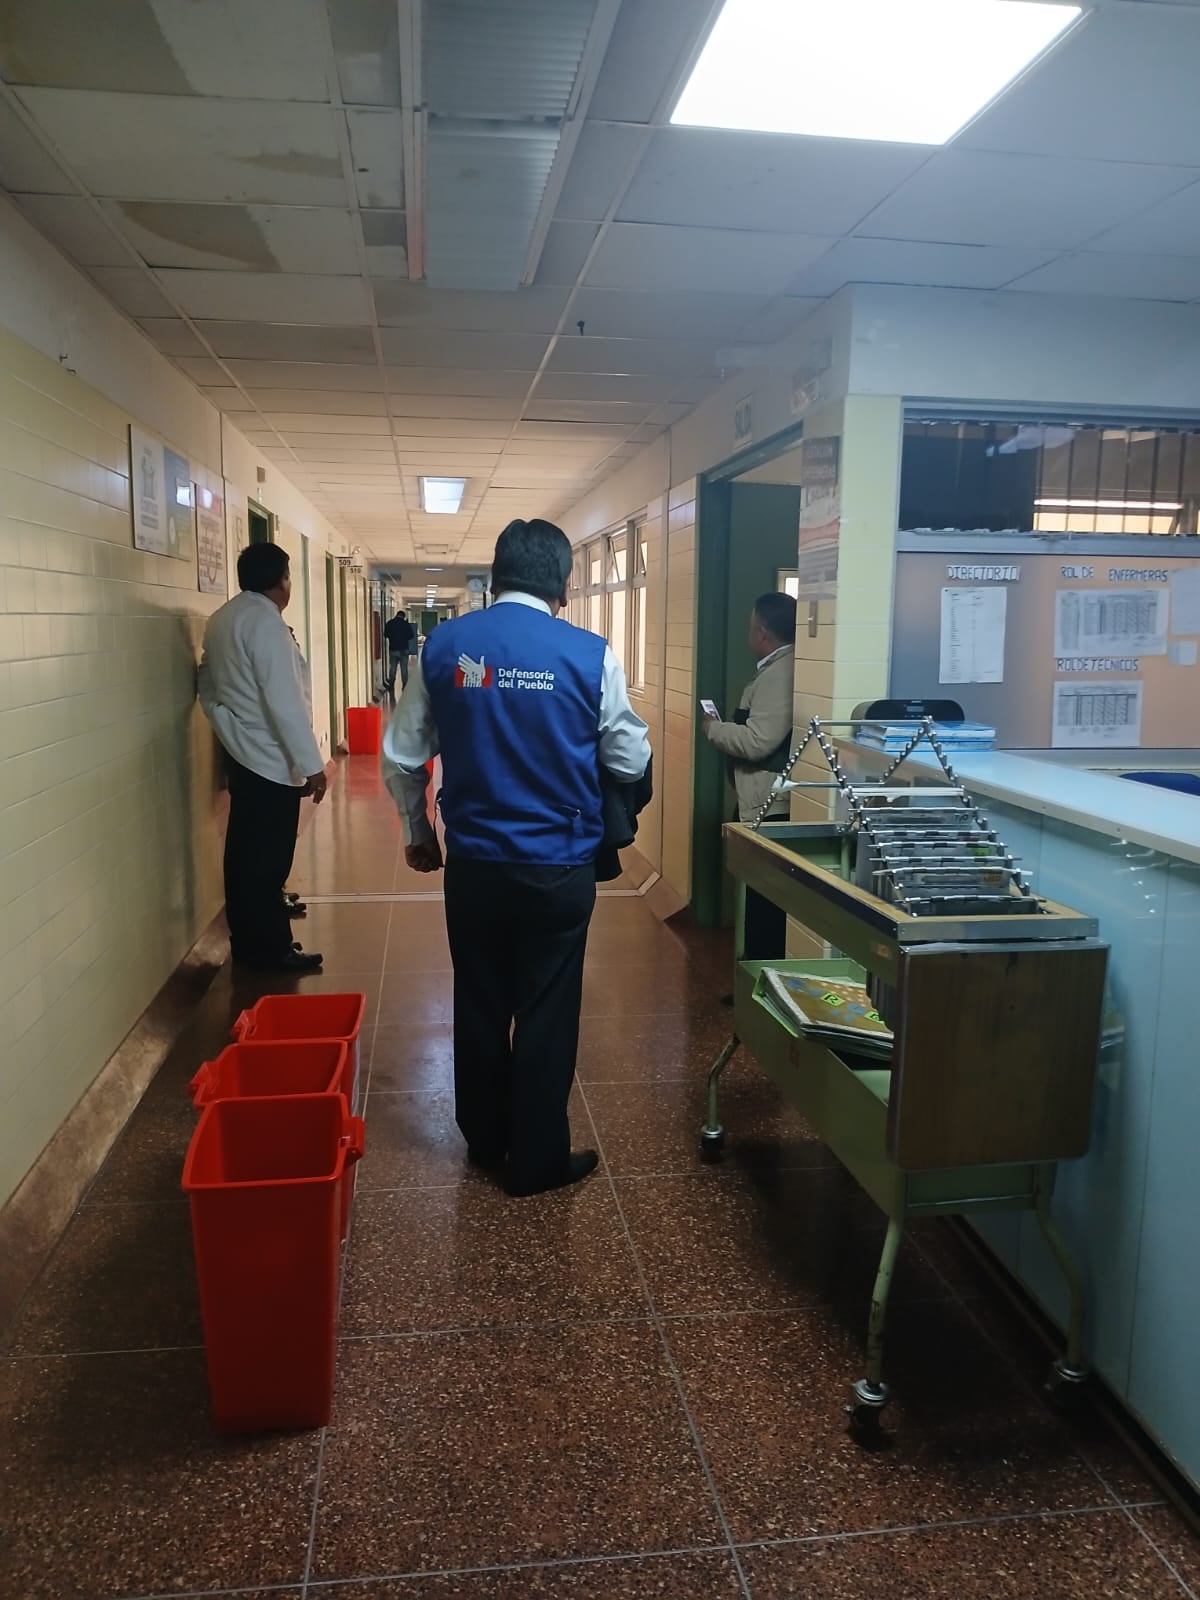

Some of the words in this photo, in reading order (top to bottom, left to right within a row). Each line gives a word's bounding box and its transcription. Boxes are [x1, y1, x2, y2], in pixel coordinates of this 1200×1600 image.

[945, 565, 1019, 581] DIRECTORIO
[1060, 566, 1079, 578] ROL
[1081, 566, 1095, 578] DE
[1108, 568, 1169, 582] ENFERMERAS
[498, 668, 555, 681] Defensoría
[498, 678, 514, 689] del
[517, 679, 554, 691] Pueblo
